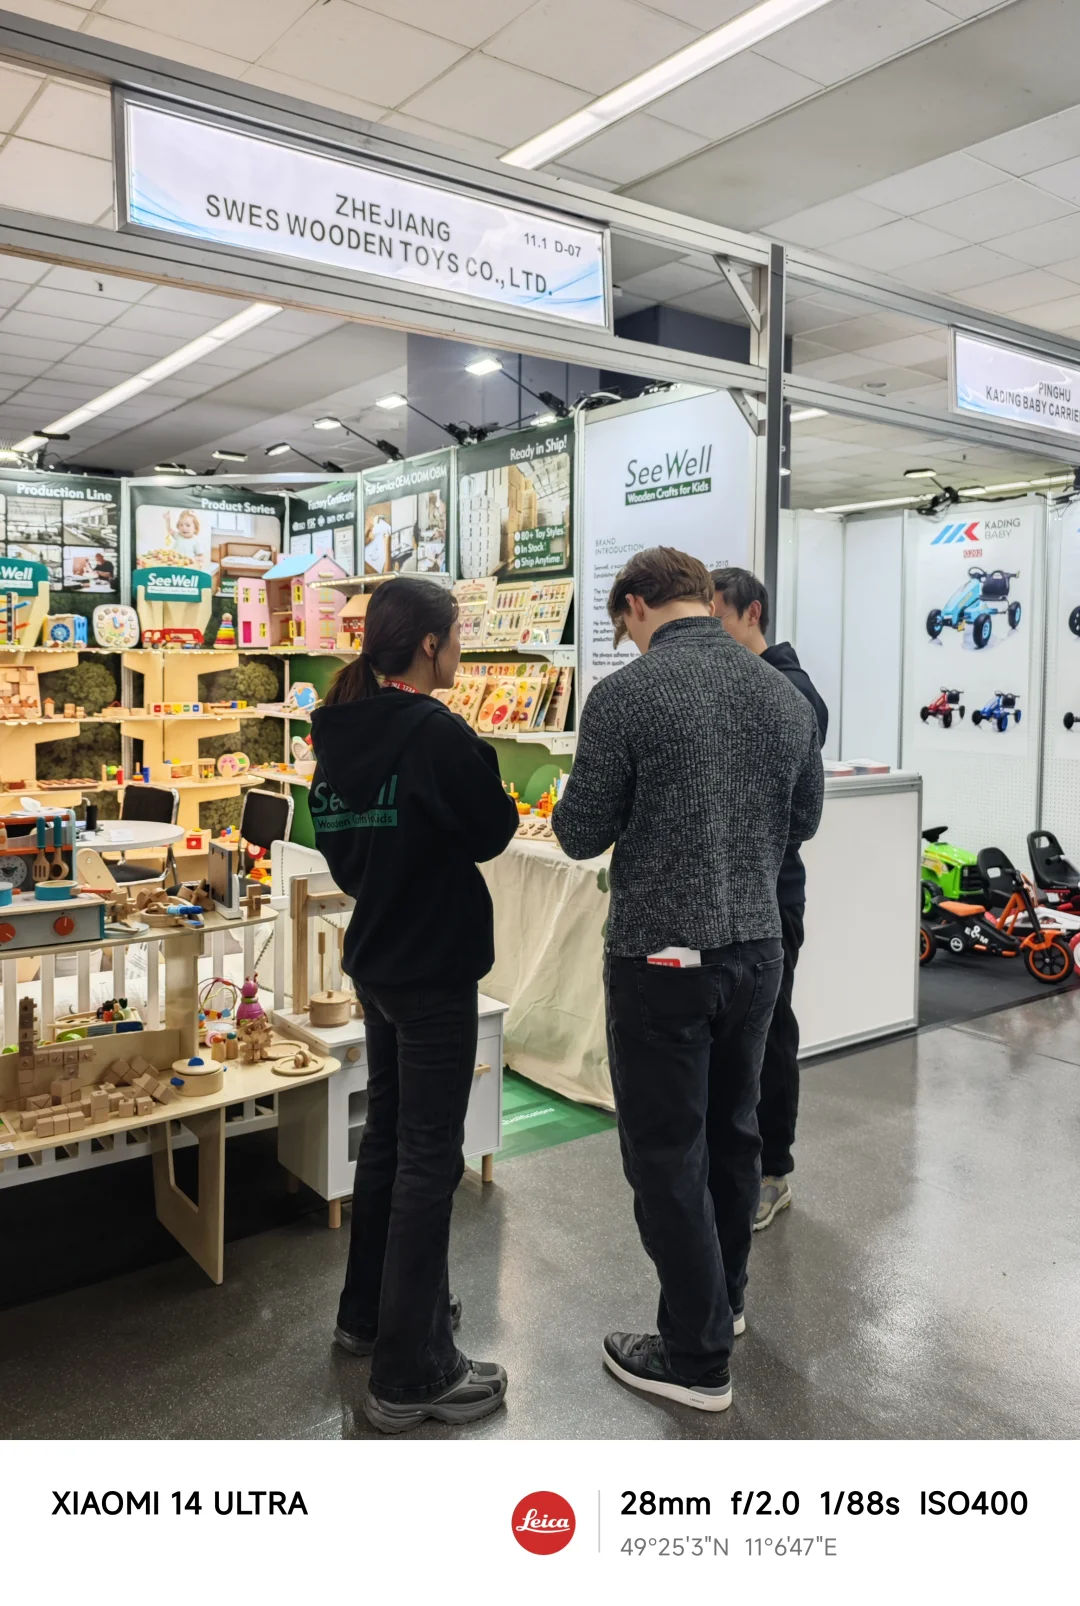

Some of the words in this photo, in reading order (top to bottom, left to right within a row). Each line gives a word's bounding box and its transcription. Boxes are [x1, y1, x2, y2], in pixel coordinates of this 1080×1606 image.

[335, 193, 451, 242] ZHEJIANG
[205, 194, 279, 231] SWES
[286, 212, 393, 258] WOODEN
[399, 239, 460, 274] TOYS
[510, 268, 553, 296] LTD.
[523, 232, 547, 250] 11.1
[554, 240, 582, 258] D-07
[985, 386, 1021, 408] KADING
[1023, 396, 1047, 415] BABY
[1038, 382, 1071, 402] PINGHU
[510, 444, 534, 461] Ready
[535, 442, 544, 455] in
[545, 434, 567, 453] Ship!
[625, 444, 712, 488] SeeWell
[376, 482, 395, 494] Service
[395, 465, 447, 489] OEM/ODM/OBM
[16, 483, 85, 499] Production
[86, 488, 113, 501] Line
[627, 490, 655, 504] Wooden
[656, 487, 678, 499] Crafts
[679, 485, 691, 495] for
[692, 482, 709, 493] Kids
[201, 498, 242, 512] Product
[243, 502, 276, 515] Series
[308, 498, 327, 511] Factory
[327, 491, 355, 506] Certificate
[984, 518, 1021, 530] KADING
[521, 530, 533, 541] 80+
[535, 529, 546, 540] Toy
[595, 537, 616, 547] BRAND
[984, 529, 1012, 540] BABY
[521, 545, 528, 553] In
[595, 543, 644, 556] INTRODUCTION
[521, 557, 534, 567] Ship
[0, 565, 33, 580] Well
[147, 572, 199, 588] SeeWell
[317, 816, 350, 829] Wooden
